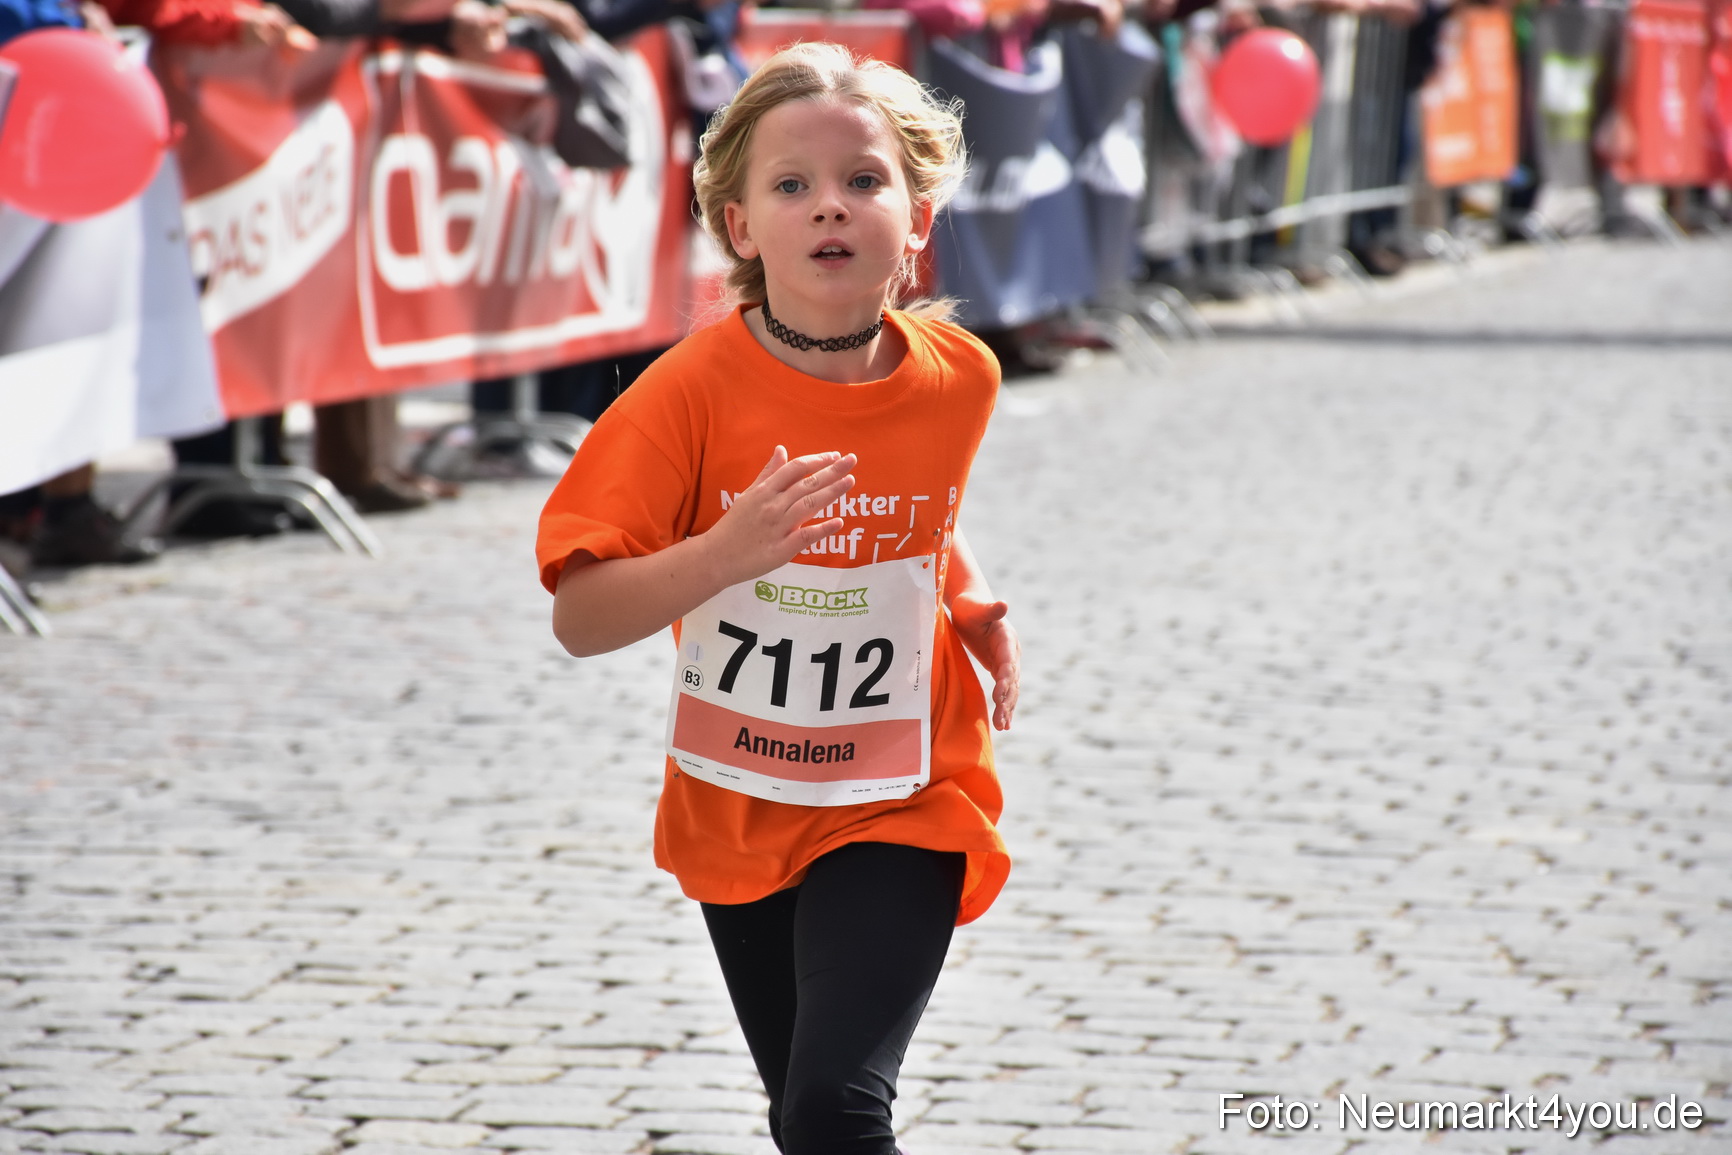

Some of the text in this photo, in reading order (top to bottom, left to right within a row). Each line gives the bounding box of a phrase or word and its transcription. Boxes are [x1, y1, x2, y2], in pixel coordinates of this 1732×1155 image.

[935, 487, 957, 606] BAMBI
[778, 606, 807, 616] inspired
[809, 608, 818, 618] by
[841, 608, 869, 617] concepts
[779, 585, 868, 610] BOCK
[685, 669, 700, 687] B3
[717, 620, 894, 712] 7112
[733, 727, 855, 764] Annalena
